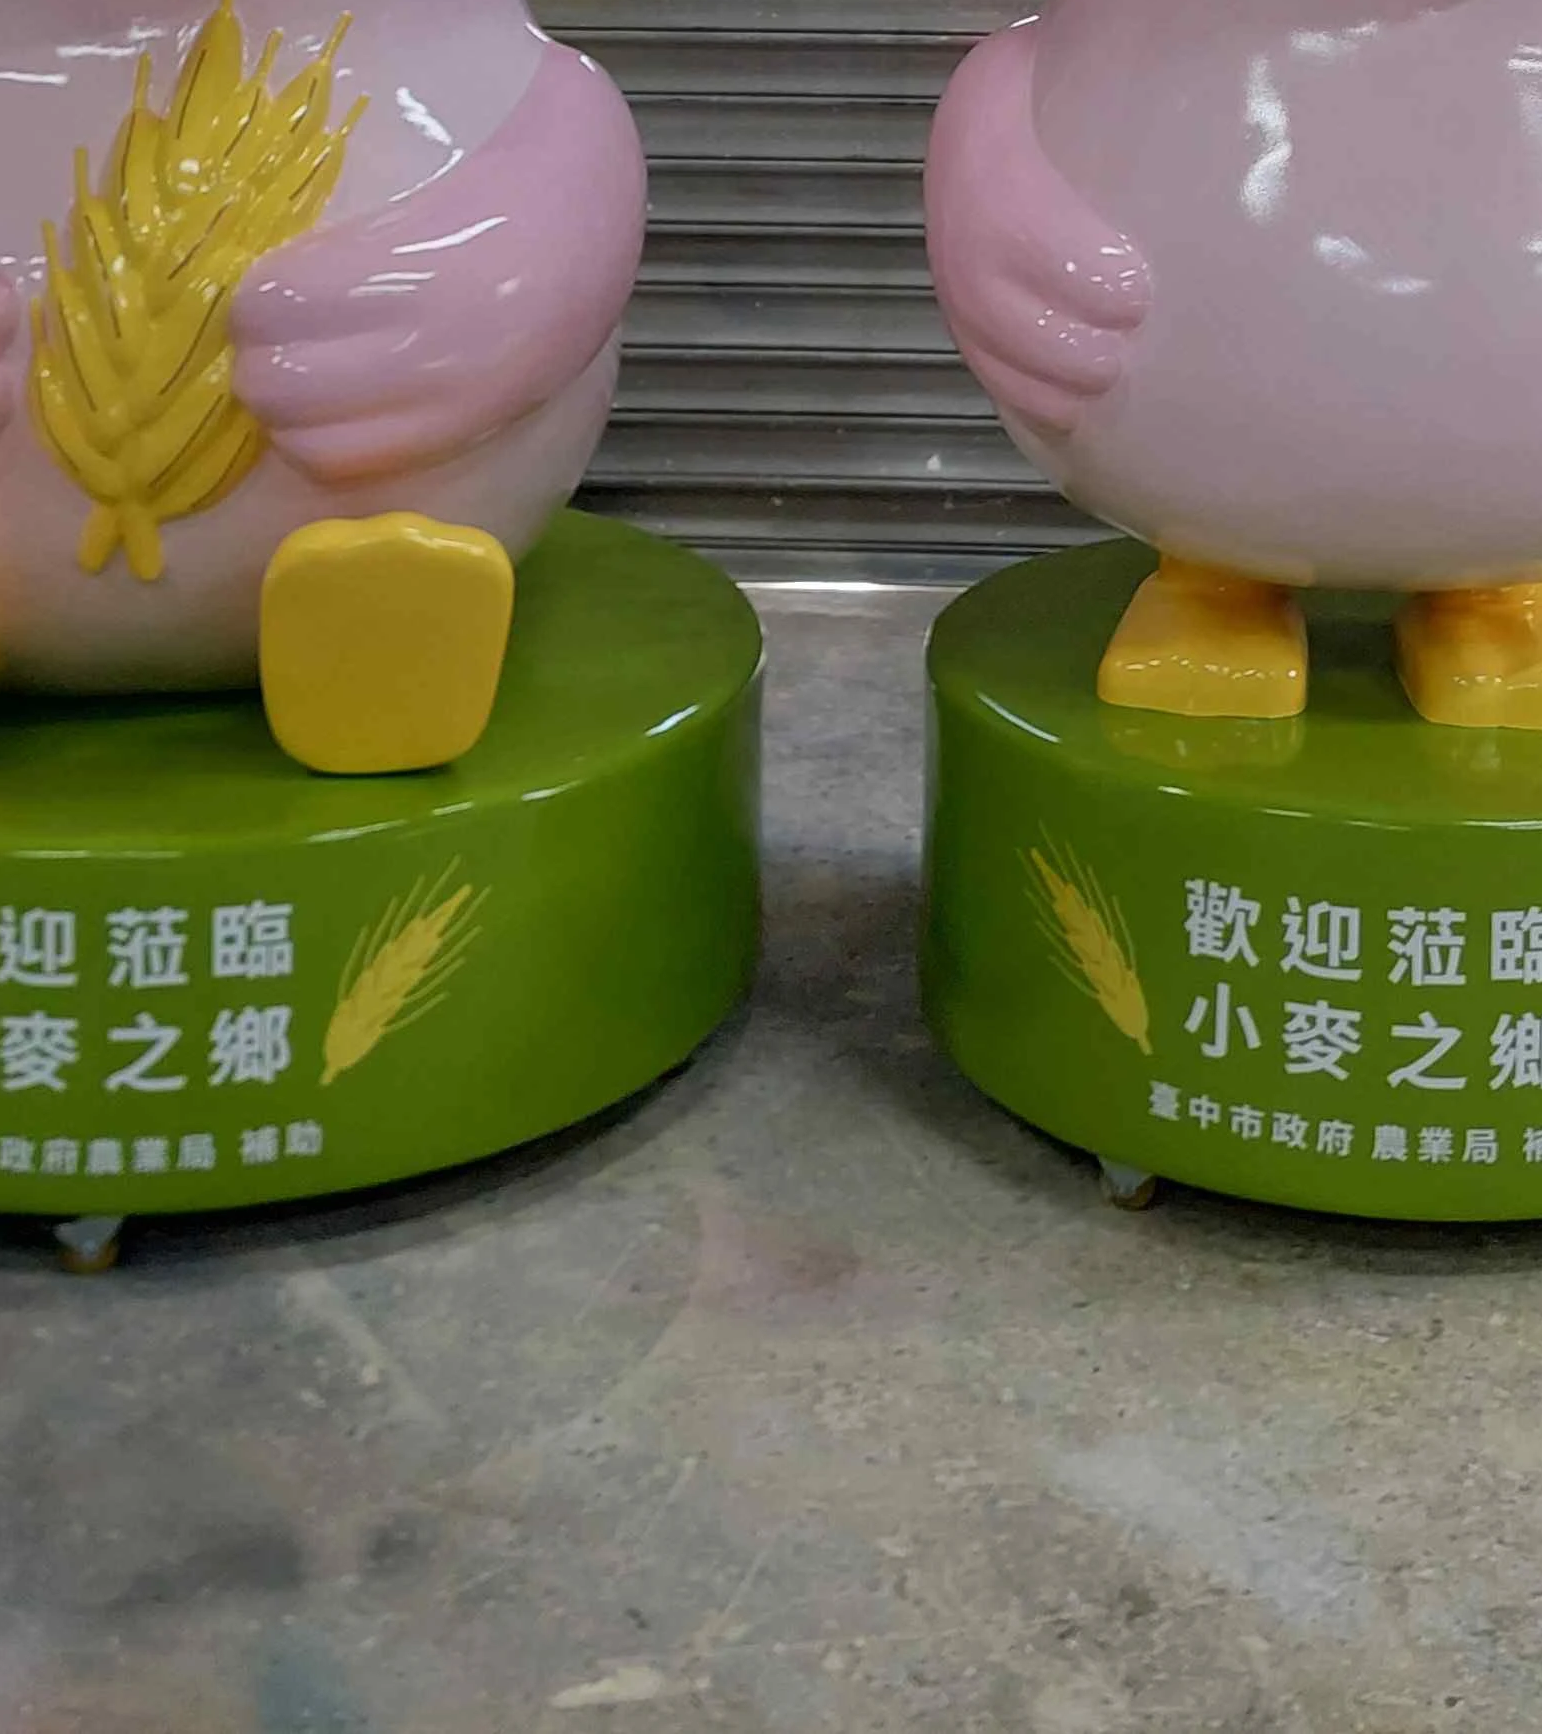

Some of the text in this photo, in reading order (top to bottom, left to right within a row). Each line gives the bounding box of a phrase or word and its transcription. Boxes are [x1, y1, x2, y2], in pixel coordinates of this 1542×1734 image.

[240, 1119, 324, 1166] 補助
[1149, 1080, 1355, 1157] 臺中市政府
[1371, 1123, 1500, 1164] 農業局
